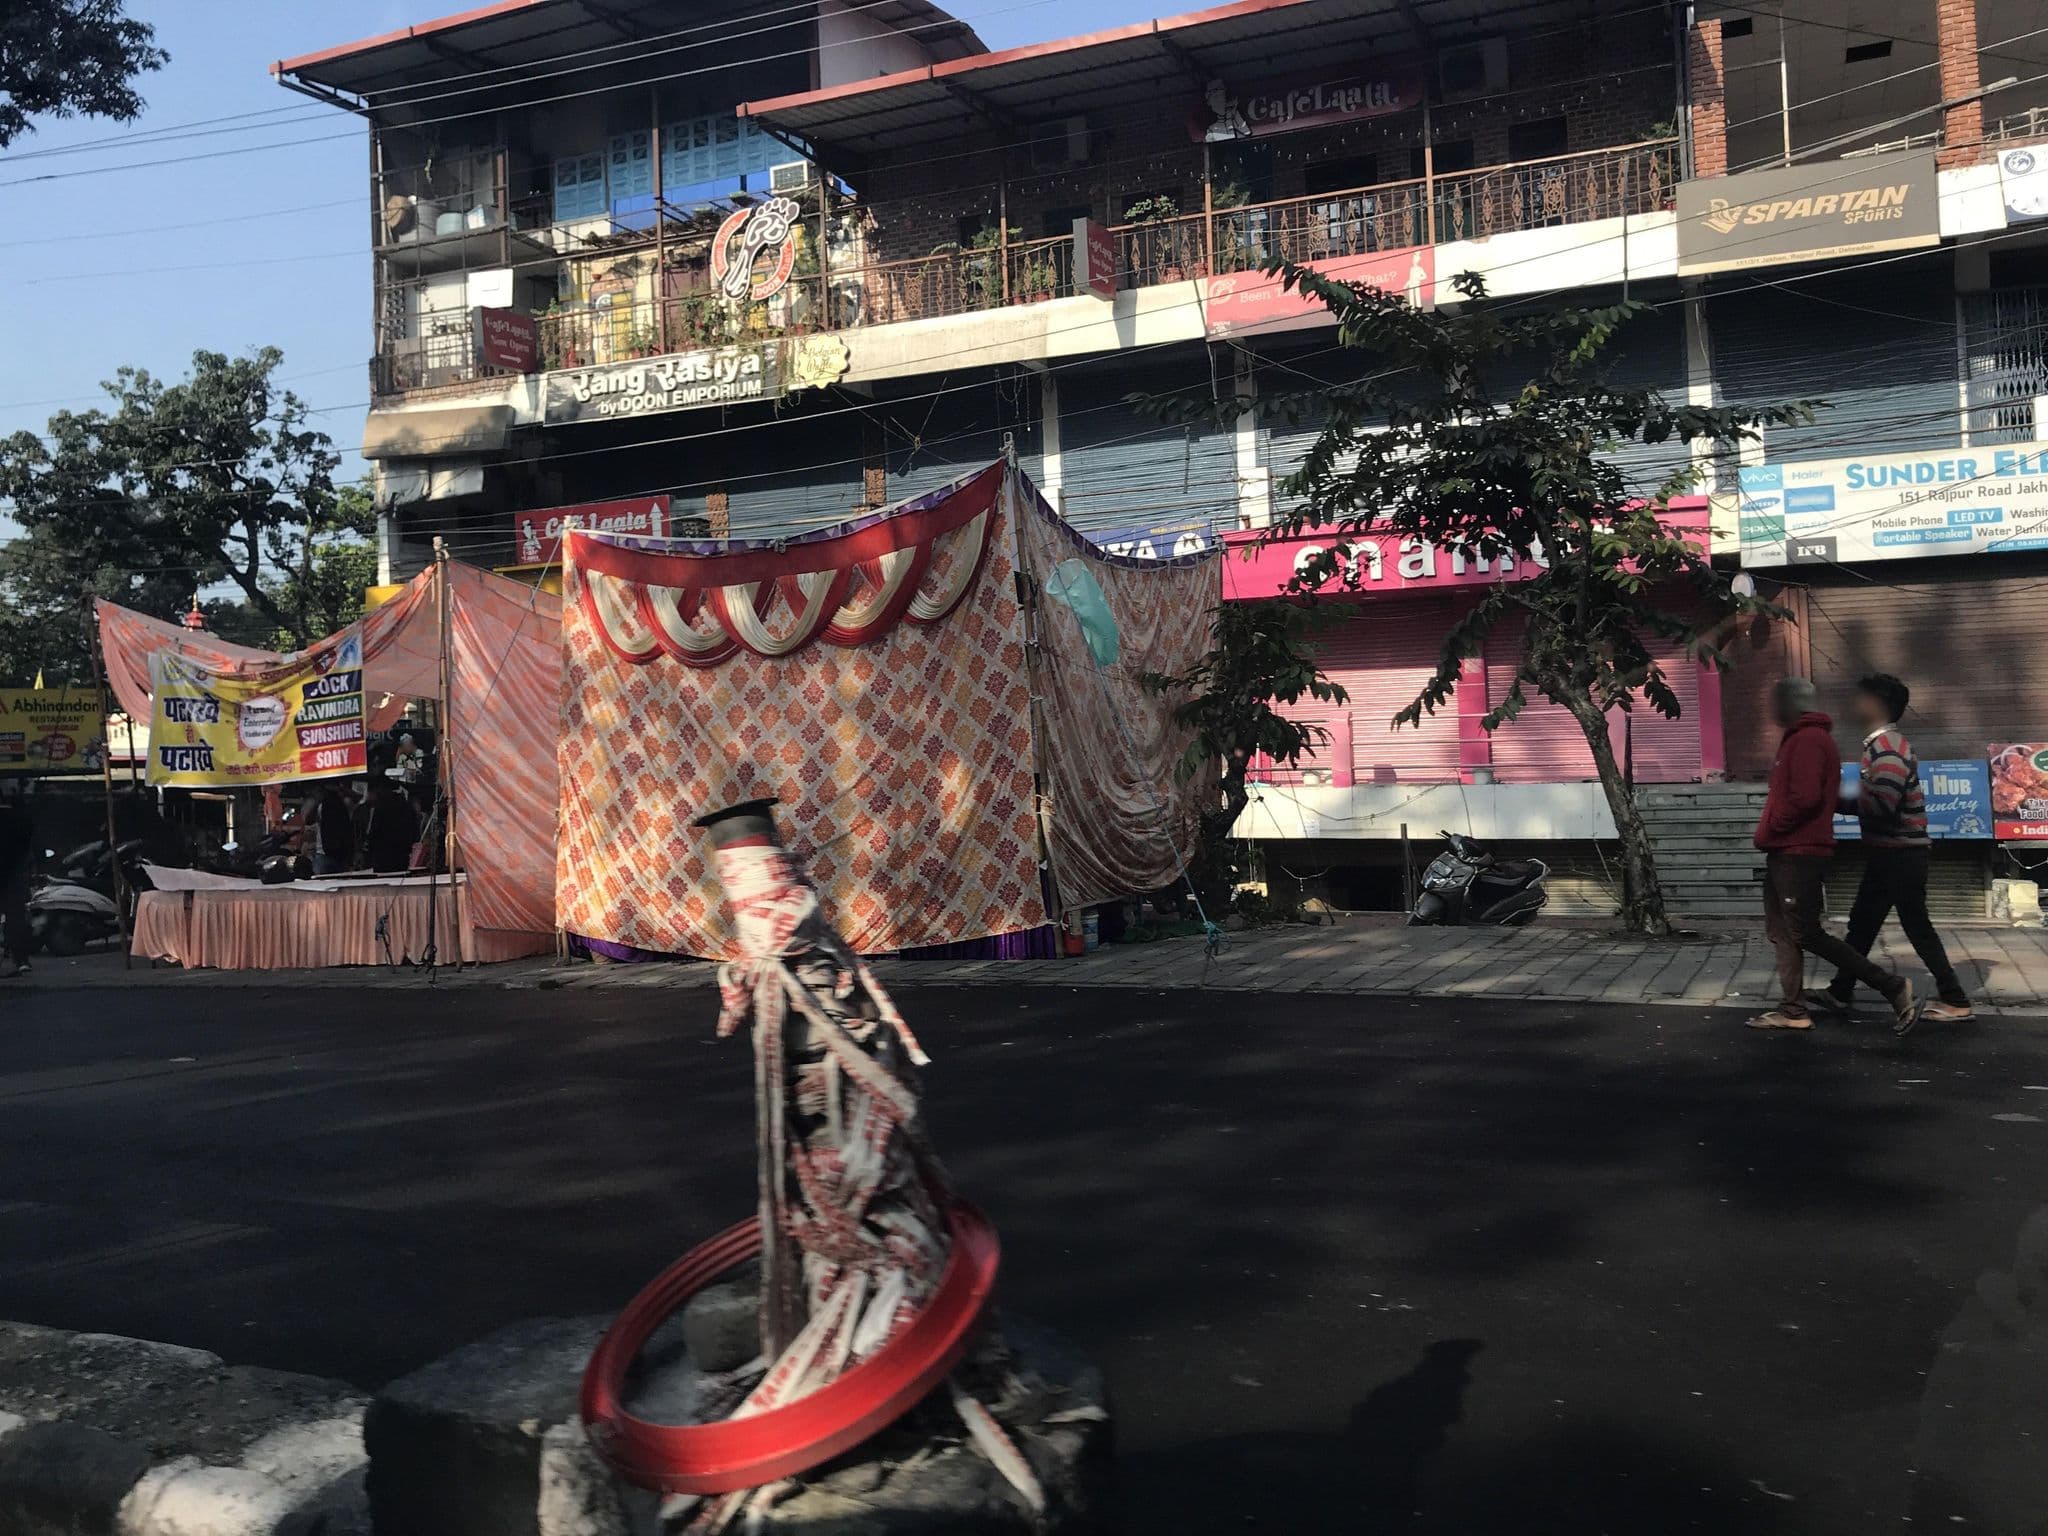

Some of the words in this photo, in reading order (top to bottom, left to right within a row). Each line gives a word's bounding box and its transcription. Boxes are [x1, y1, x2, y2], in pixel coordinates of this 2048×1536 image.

[1743, 184, 1909, 225] SPARTAN
[1844, 206, 1904, 225] SPORTS
[1239, 291, 1271, 304] Been
[572, 368, 646, 403] Rang
[653, 351, 761, 391] Rasiya
[600, 401, 618, 415] by
[619, 391, 668, 412] DOON
[673, 379, 762, 405] EMPORIUM
[1792, 470, 1824, 480] Haier
[1845, 459, 1978, 490] SUNDER
[1928, 488, 1974, 503] Rajpur
[1978, 483, 2012, 498] Road
[545, 514, 585, 538] Ca
[1871, 518, 1907, 529] Mobile
[1910, 516, 1943, 527] Phone
[1954, 512, 1975, 523] LED
[1980, 510, 1995, 521] TV
[1924, 528, 1970, 542] Speaker
[1976, 527, 2012, 538] Water
[2016, 524, 2048, 537] Purifi
[1293, 522, 1615, 587] enamo
[1797, 545, 1827, 557] IFB
[14, 697, 99, 712] Abhinandan
[297, 698, 360, 722] RAVINDRA
[301, 723, 361, 746] SUNSHINE
[159, 738, 215, 772] पटाखे
[316, 749, 349, 768] SONY
[1933, 774, 1972, 796] HUB
[1925, 797, 1978, 813] undry
